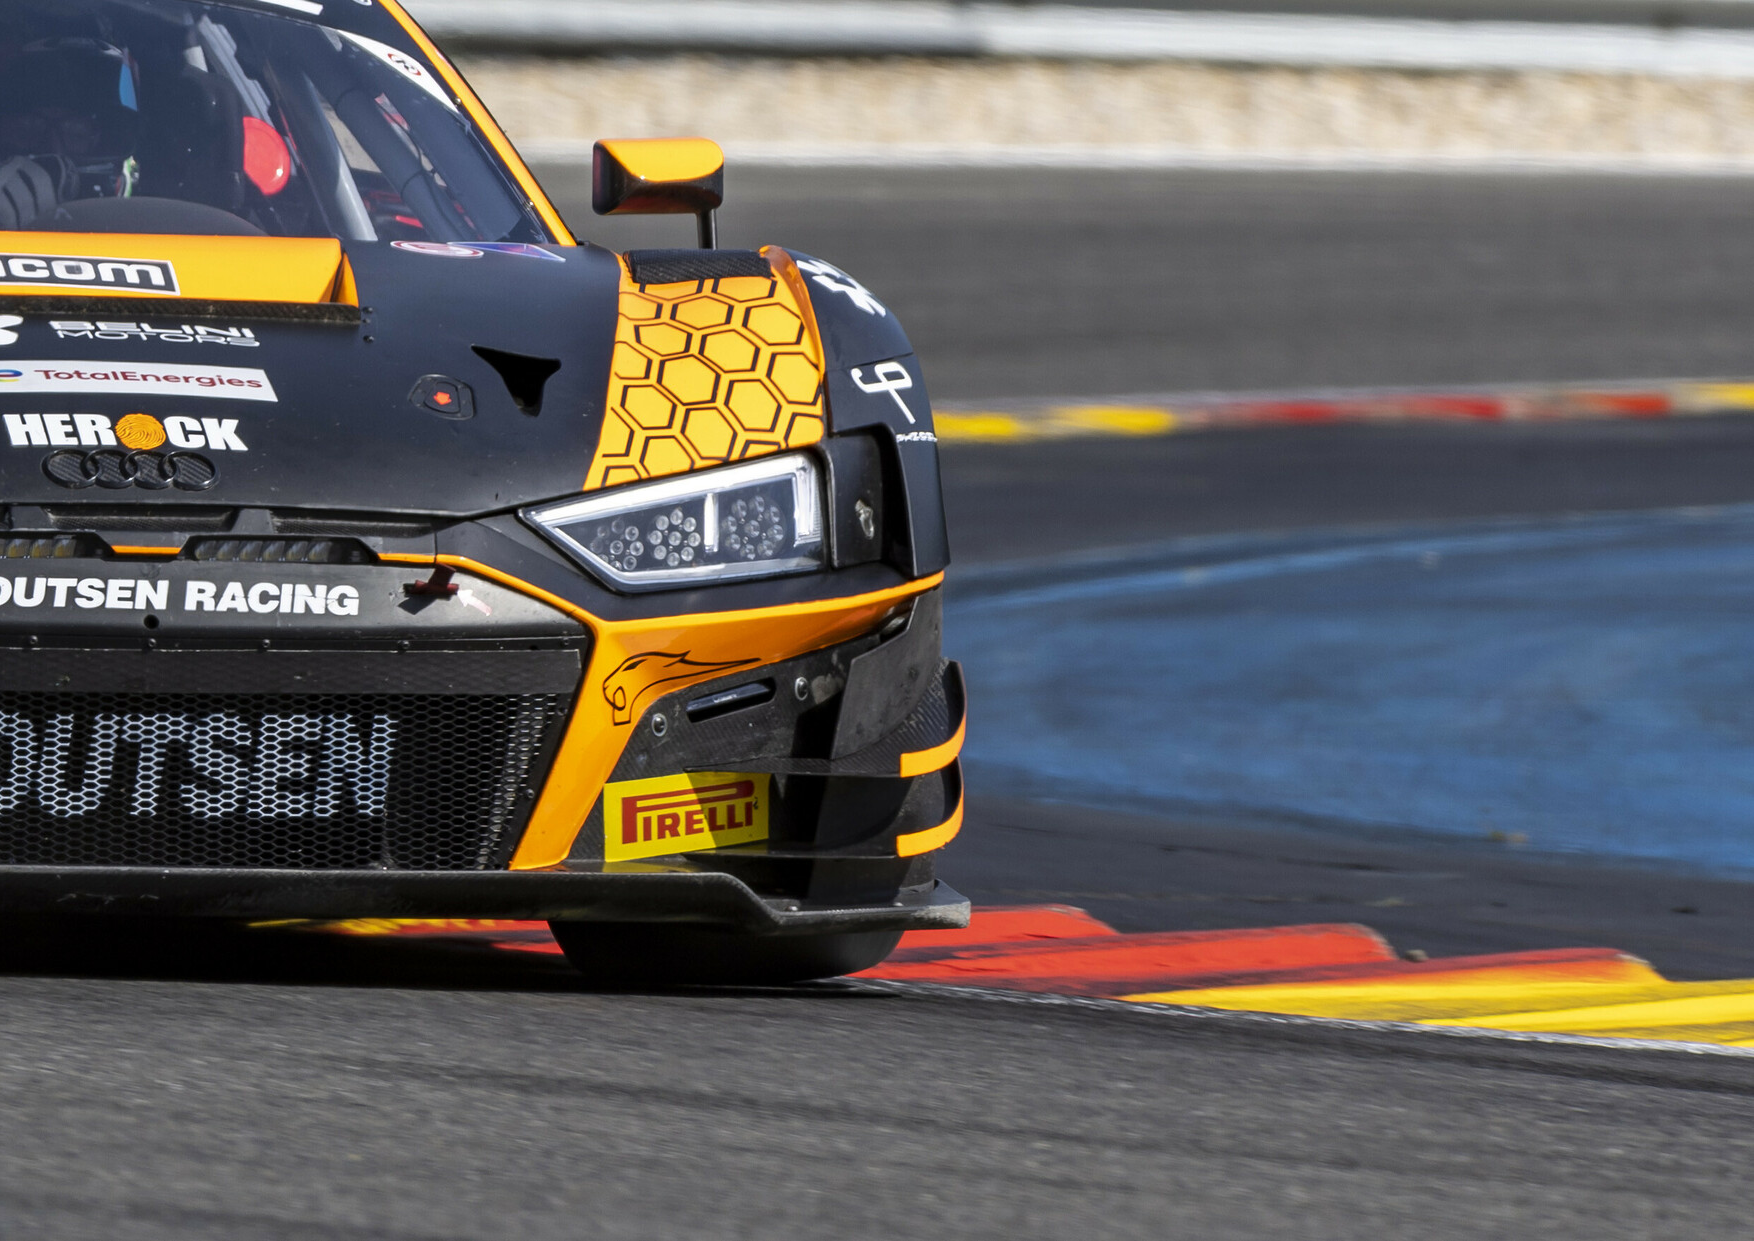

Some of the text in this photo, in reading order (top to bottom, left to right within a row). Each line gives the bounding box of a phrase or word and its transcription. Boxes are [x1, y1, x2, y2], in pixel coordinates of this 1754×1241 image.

[49, 320, 255, 339] BELINI
[57, 330, 260, 347] MOTORS
[35, 369, 263, 389] TotalEnergies
[184, 581, 360, 616] RACING
[621, 780, 755, 845] PIRELLI
